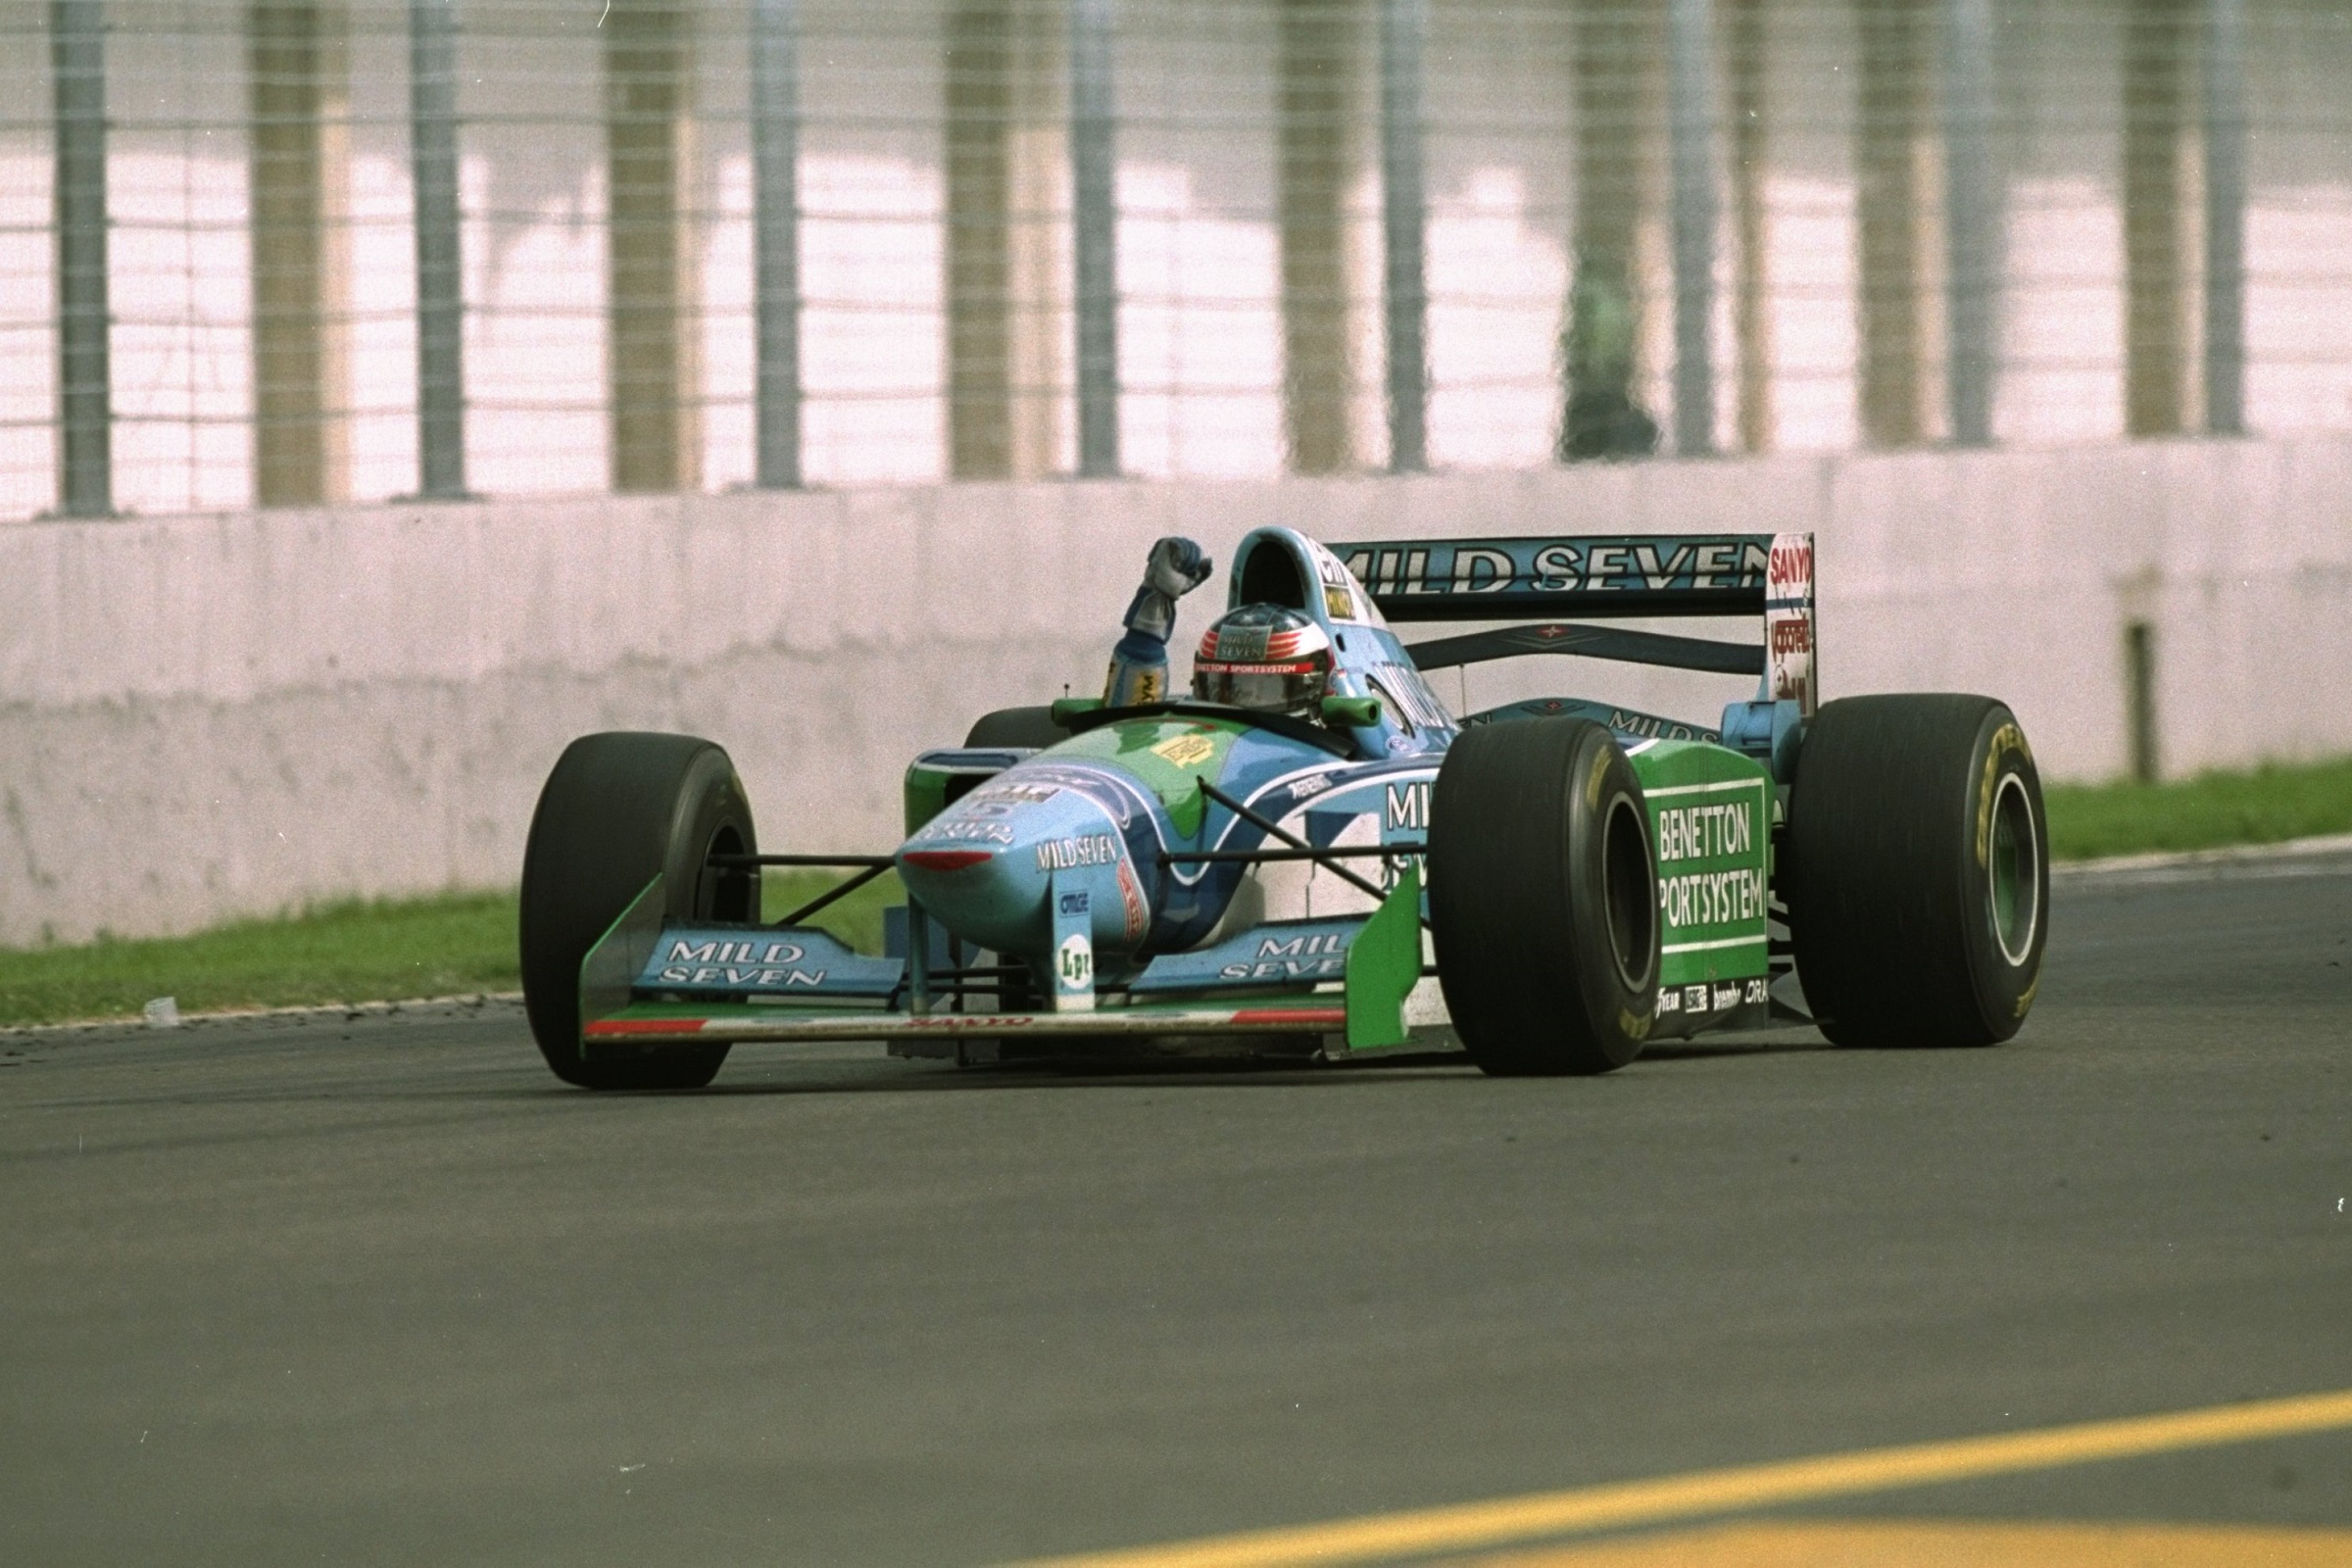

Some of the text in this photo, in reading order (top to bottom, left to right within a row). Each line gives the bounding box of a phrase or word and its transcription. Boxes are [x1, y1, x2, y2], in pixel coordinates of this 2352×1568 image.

[1770, 547, 1812, 585] SANYO
[1386, 781, 1430, 832] MI
[1659, 802, 1750, 861] BENETTON
[1036, 833, 1117, 873] MILD SEVEN
[1658, 867, 1763, 927] PORTSYSTEM
[667, 940, 806, 964] MILD
[1256, 934, 1345, 958] MIL
[659, 965, 827, 987] SEVEN
[1219, 958, 1345, 979] SEVE
